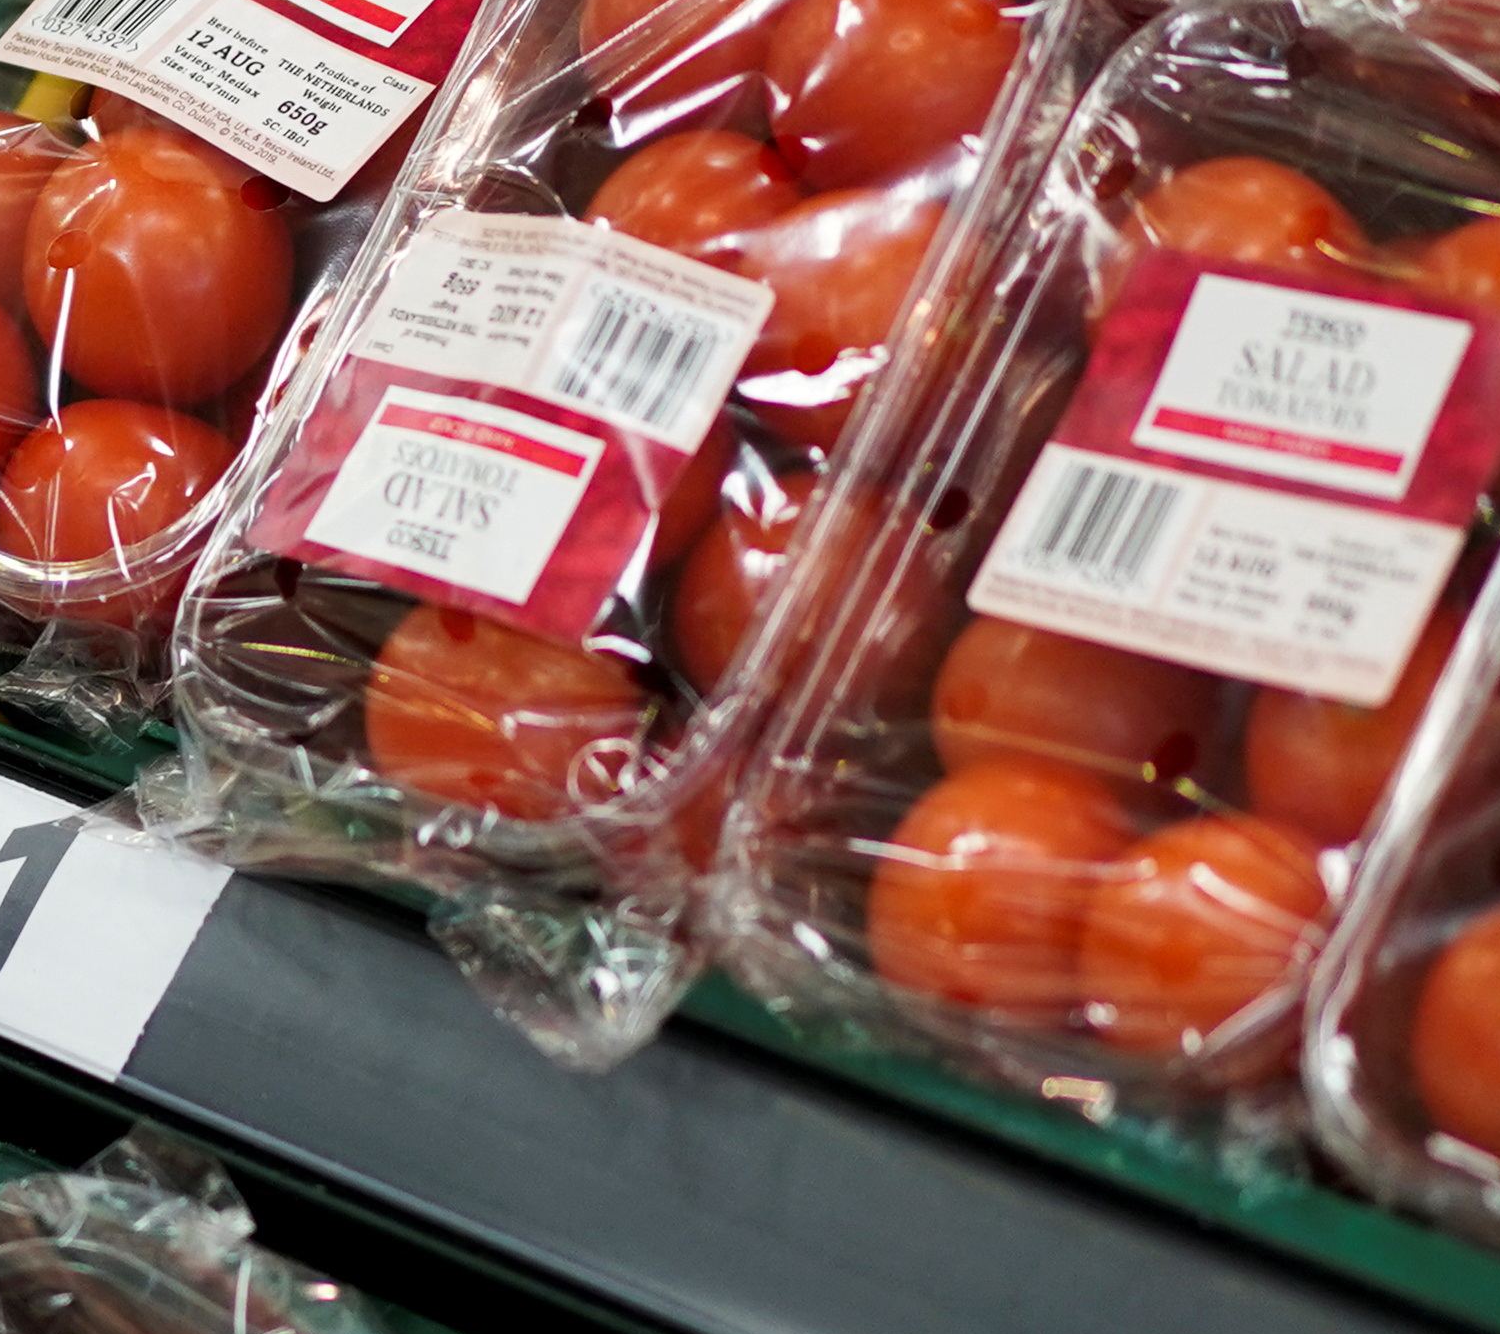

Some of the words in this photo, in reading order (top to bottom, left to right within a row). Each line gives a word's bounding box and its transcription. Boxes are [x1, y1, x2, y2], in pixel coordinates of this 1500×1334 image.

[187, 29, 214, 49] 12
[213, 44, 265, 77] AUG
[207, 17, 233, 34] Best
[234, 30, 269, 55] before
[161, 56, 186, 75] Size:
[189, 72, 241, 105] 40-47mm
[173, 45, 216, 77] Variety:
[217, 69, 260, 99] Mediax
[278, 58, 301, 77] THE
[302, 72, 390, 117] NETHERLANDS
[315, 61, 360, 88] Produce
[362, 84, 376, 94] of
[382, 75, 410, 93] Class
[277, 100, 328, 136] 650g
[302, 88, 343, 114] Weight
[383, 471, 502, 530] SALAD
